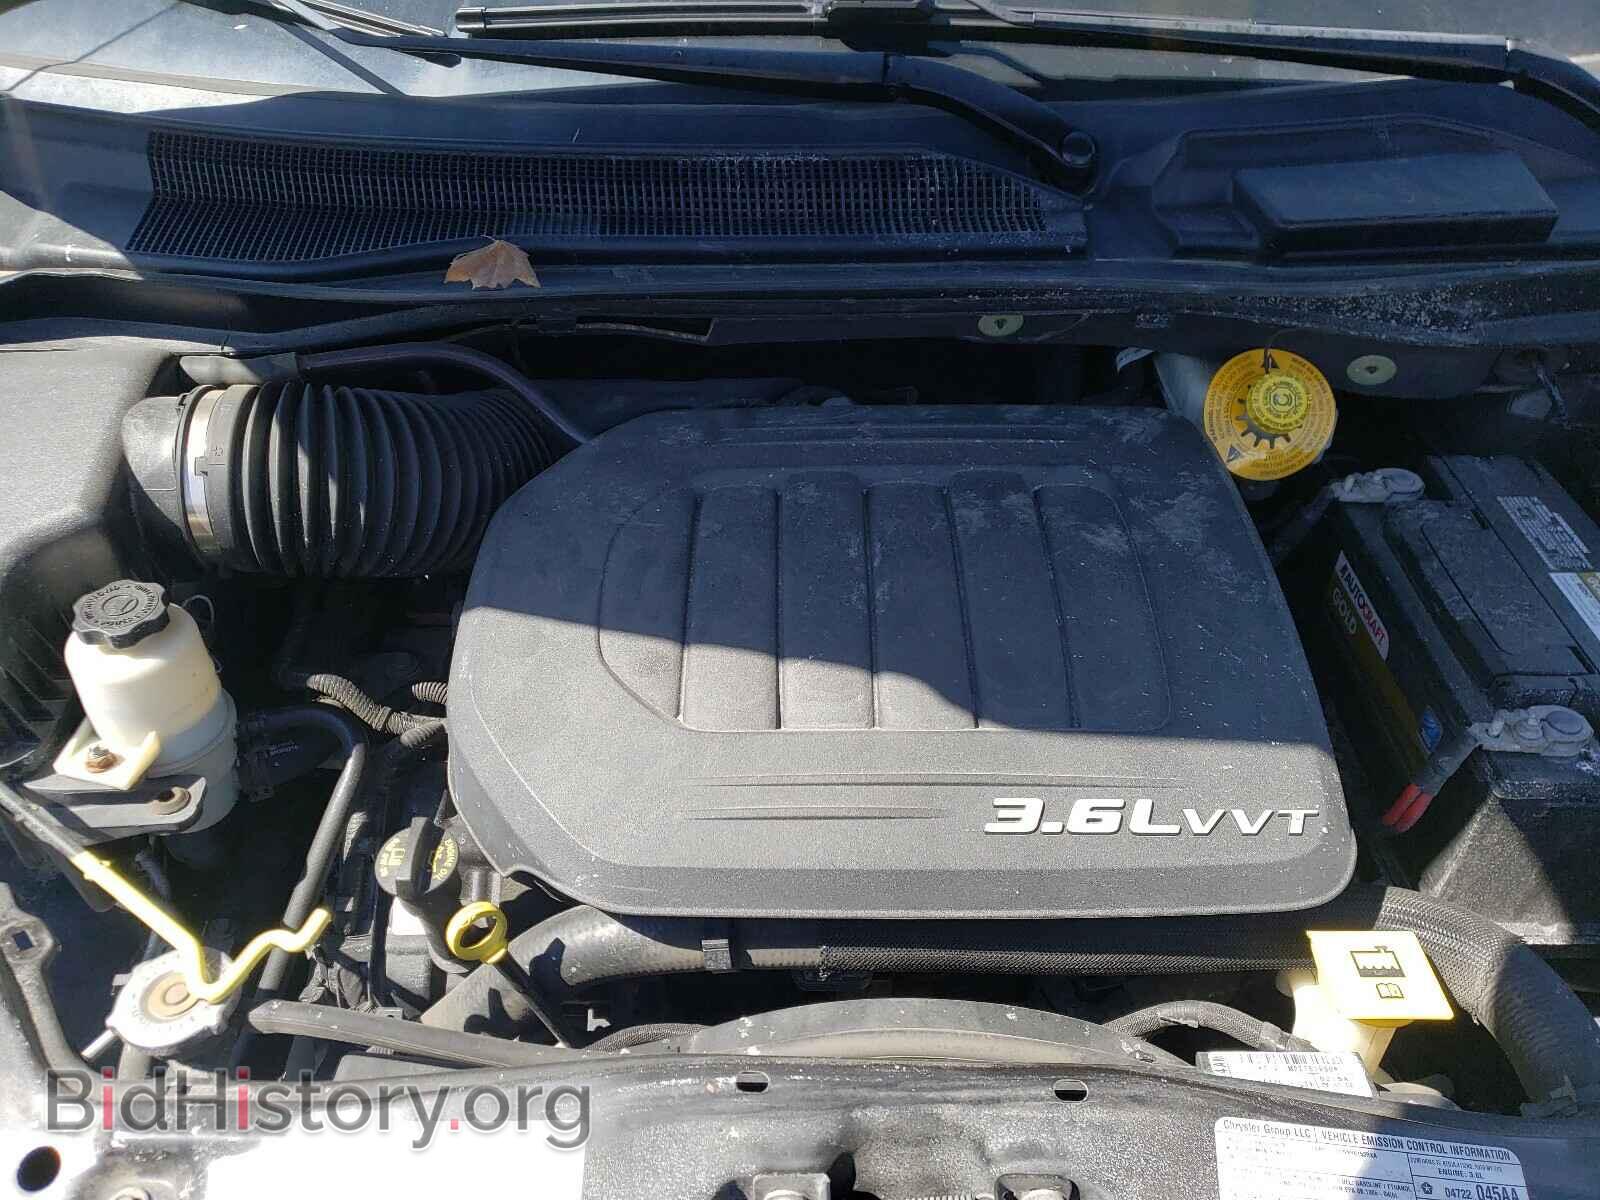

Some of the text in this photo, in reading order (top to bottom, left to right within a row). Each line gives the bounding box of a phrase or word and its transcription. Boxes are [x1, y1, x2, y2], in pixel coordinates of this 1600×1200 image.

[1182, 808, 1320, 836] VVT
[1223, 1119, 1511, 1160] Chrysler Group LLC VEHICLE EMISSION CONTROL INFORMATION
[1444, 1187, 1472, 1200] 04722
